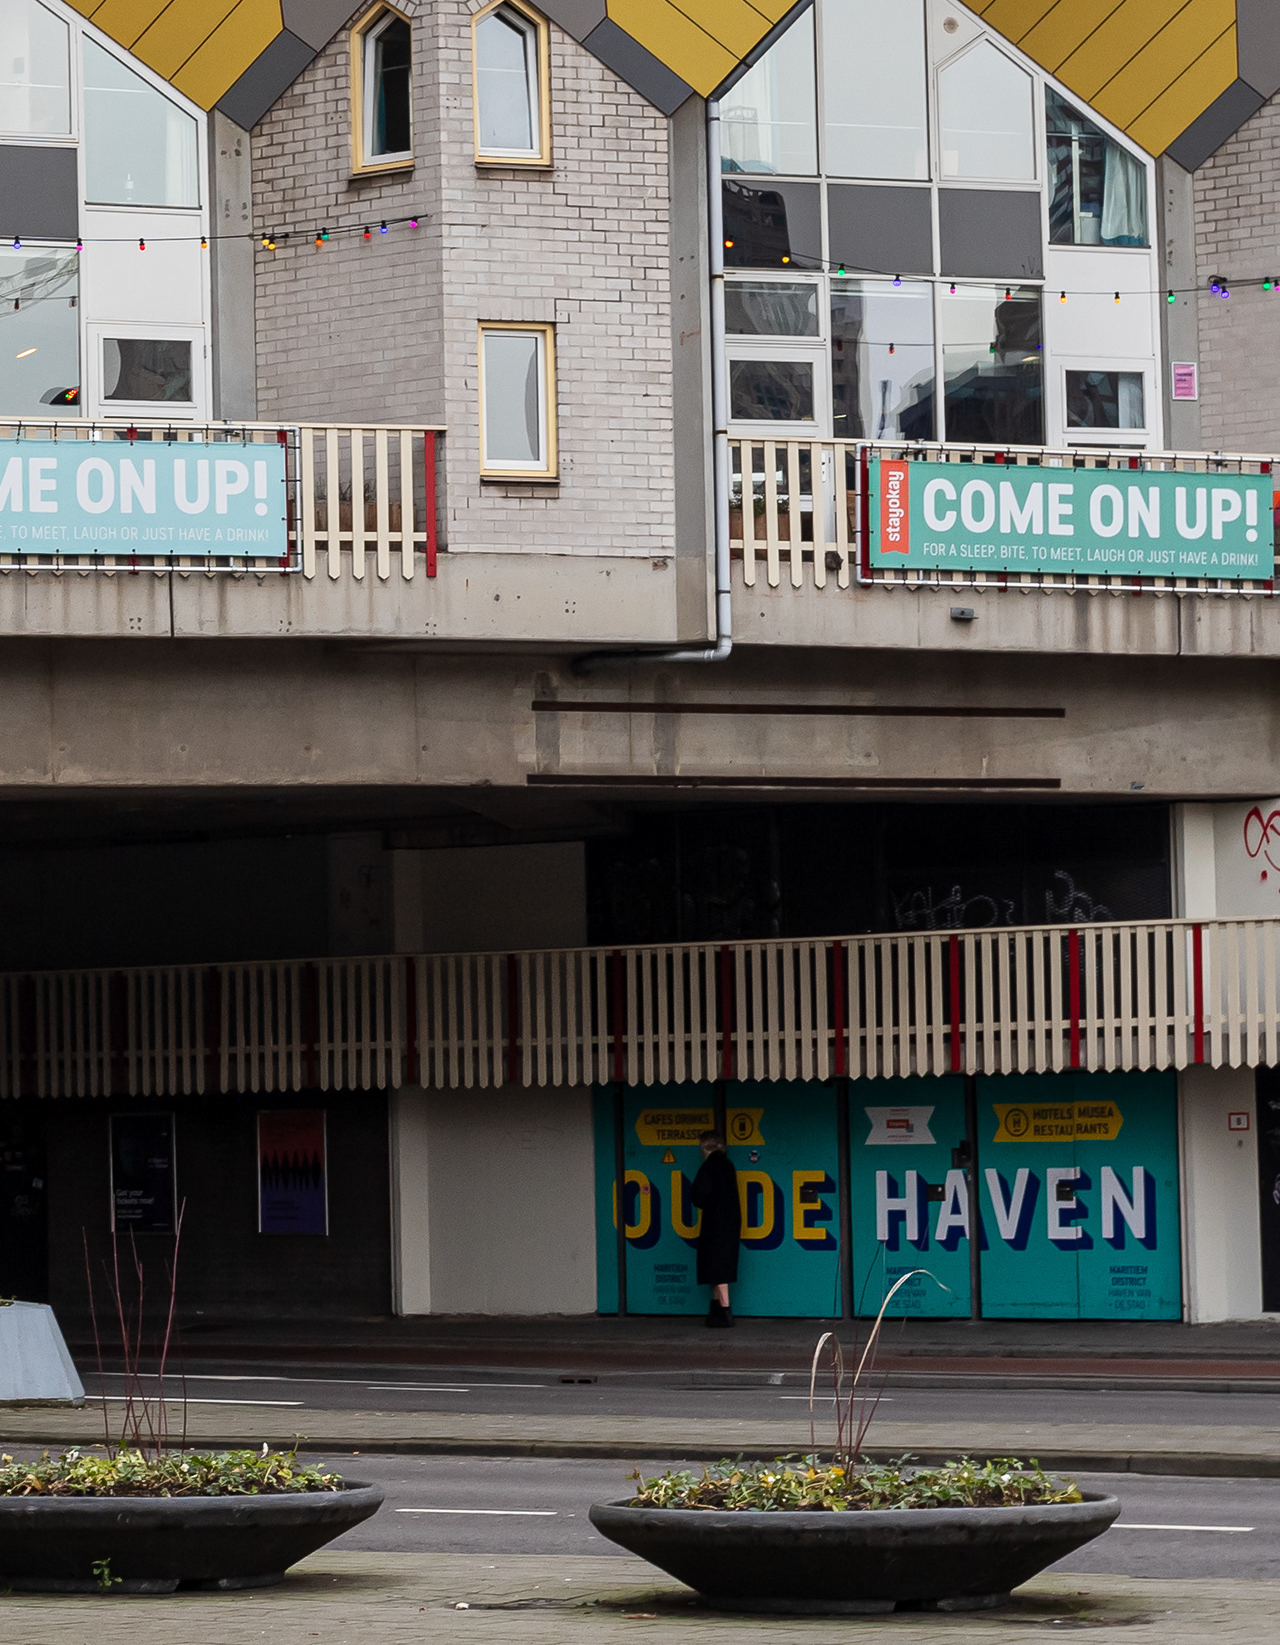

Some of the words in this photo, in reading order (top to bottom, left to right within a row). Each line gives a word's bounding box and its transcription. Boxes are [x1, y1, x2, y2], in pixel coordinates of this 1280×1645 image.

[76, 457, 157, 514] ON
[173, 458, 268, 516] UP!
[885, 471, 904, 542] stayokay
[923, 478, 1074, 536] COME
[1089, 484, 1161, 539] ON
[1175, 486, 1258, 543] UP!
[11, 525, 28, 539] TO
[73, 526, 117, 540] LAUGH
[120, 527, 138, 540] OR
[142, 527, 175, 541] JUST
[178, 528, 211, 541] HAVE
[214, 528, 224, 541] A
[227, 528, 269, 542] DRINK!
[923, 543, 948, 556] FOR
[949, 543, 957, 556] A
[1032, 546, 1047, 560] TO
[1087, 548, 1125, 562] LAUGH
[1128, 549, 1144, 562] OR
[1147, 550, 1175, 563] JUST
[1179, 551, 1207, 564] HAVE
[1210, 552, 1219, 564] A
[1221, 552, 1258, 566] DRINK!
[675, 1113, 709, 1124] DRINKS
[1033, 1108, 1073, 1120] HOTELS
[1078, 1105, 1114, 1118] MUSEA
[875, 1166, 1147, 1241] HAVEN
[1109, 1265, 1148, 1275] MARITIEM
[1112, 1277, 1146, 1286] DISTRICT
